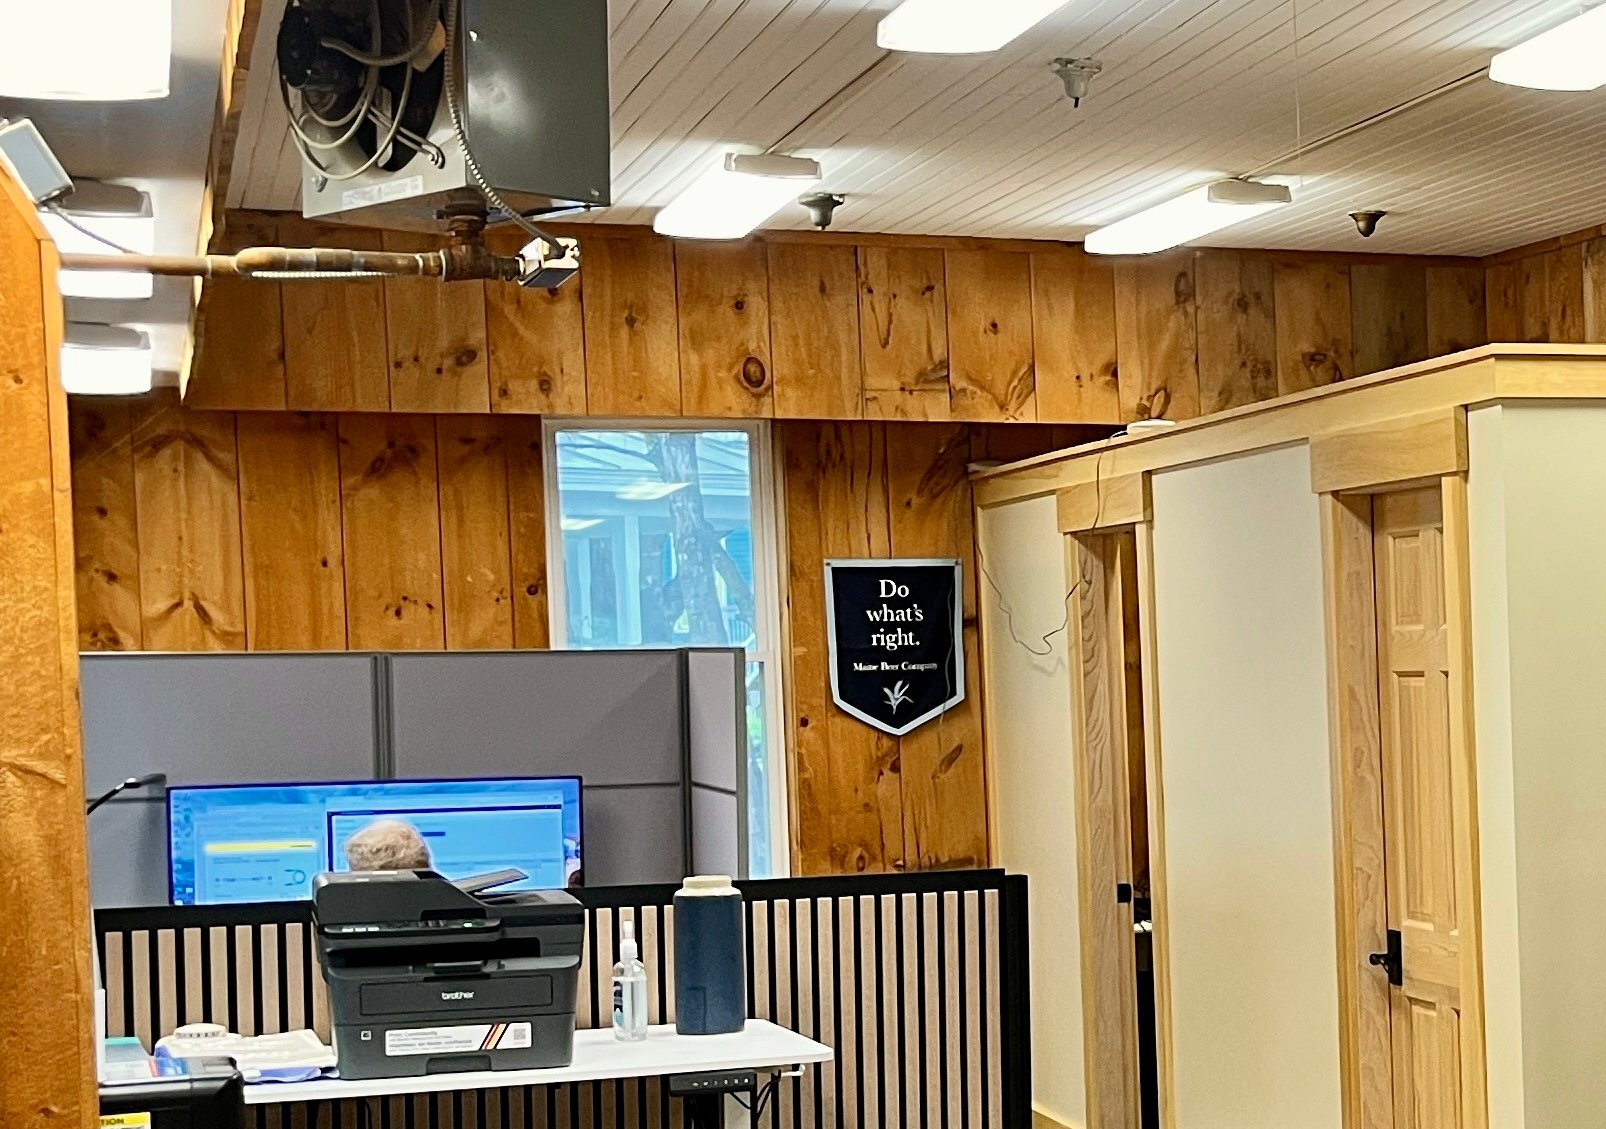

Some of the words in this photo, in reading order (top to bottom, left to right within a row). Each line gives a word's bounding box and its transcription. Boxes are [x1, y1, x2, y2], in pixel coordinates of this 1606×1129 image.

[879, 579, 910, 598] Do
[865, 603, 924, 622] what's
[871, 627, 921, 651] right.
[901, 661, 938, 672] Company
[441, 991, 475, 1000] brother
